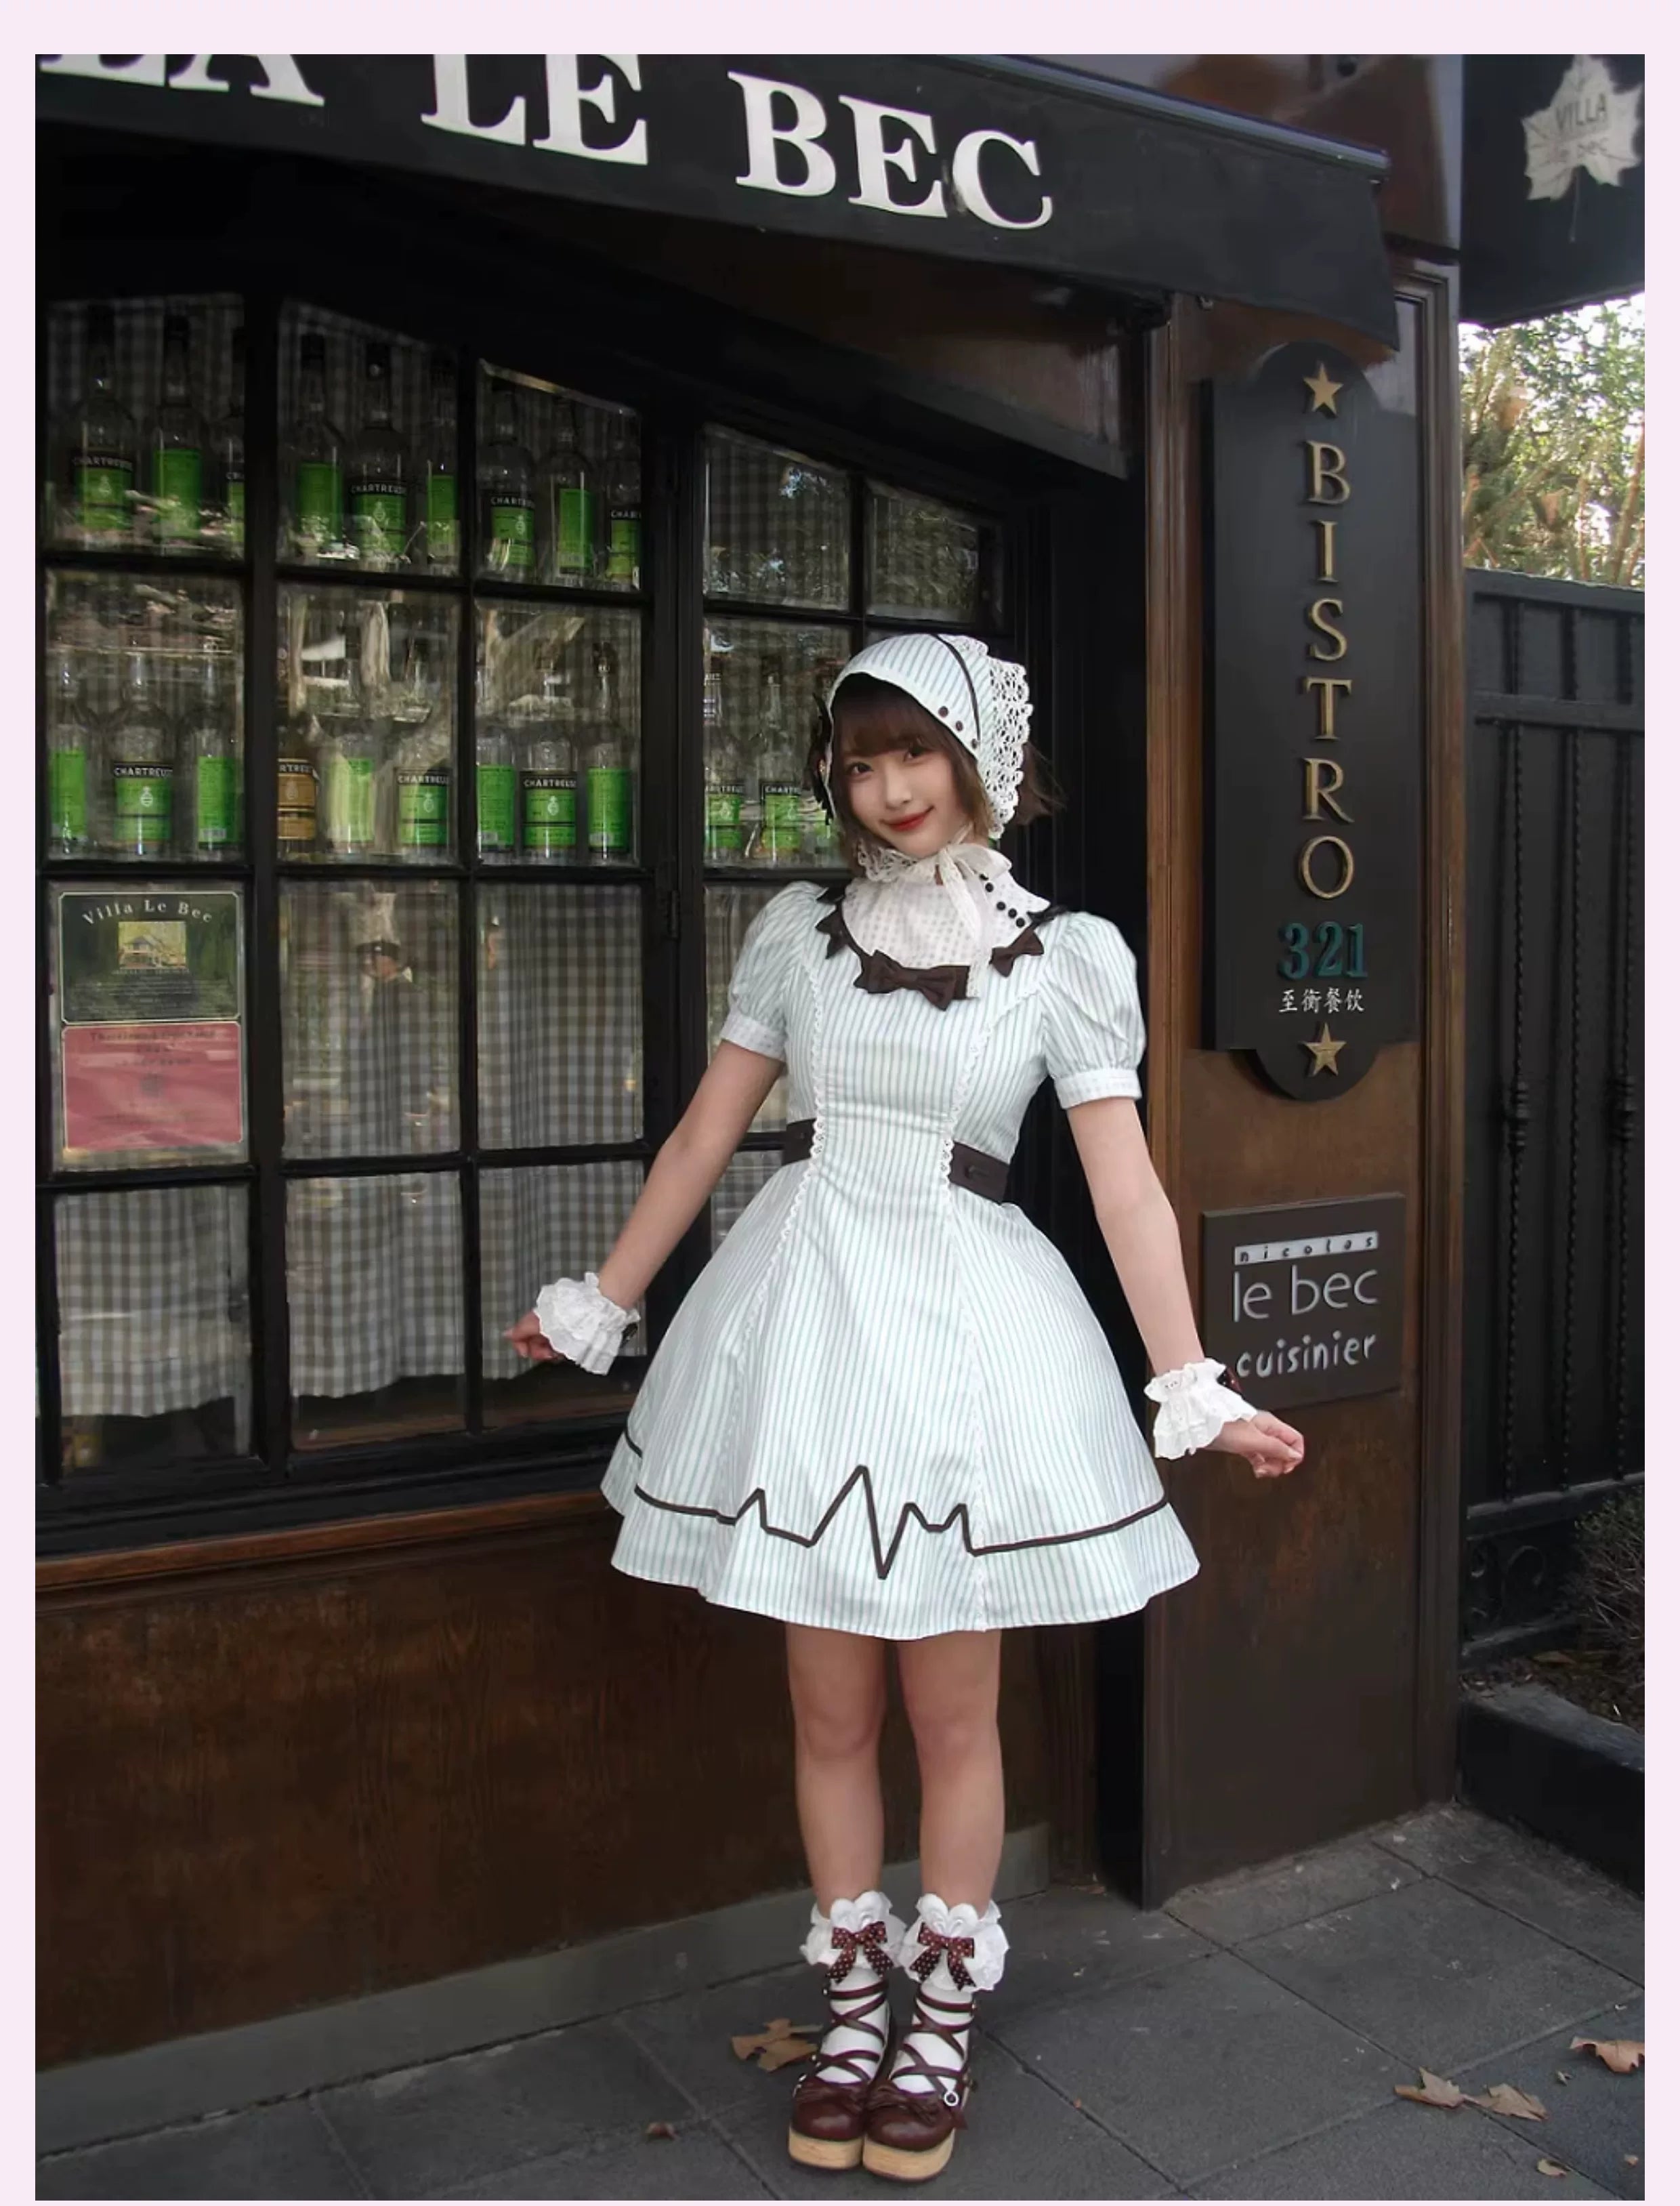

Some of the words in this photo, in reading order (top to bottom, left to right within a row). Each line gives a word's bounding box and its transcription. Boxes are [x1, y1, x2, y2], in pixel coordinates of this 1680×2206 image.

[1555, 92, 1608, 131] VILLA
[421, 54, 648, 165] LE
[727, 70, 1053, 230] BEC
[1299, 439, 1355, 899] BISTRO
[82, 899, 133, 925] Villa
[144, 899, 167, 913] Le
[177, 901, 213, 923] Bec
[1278, 921, 1368, 980] 321
[1239, 1234, 1374, 1262] nicolas
[1233, 1270, 1273, 1323] le
[1291, 1264, 1380, 1315] bec
[1236, 1330, 1377, 1378] cuisinier
